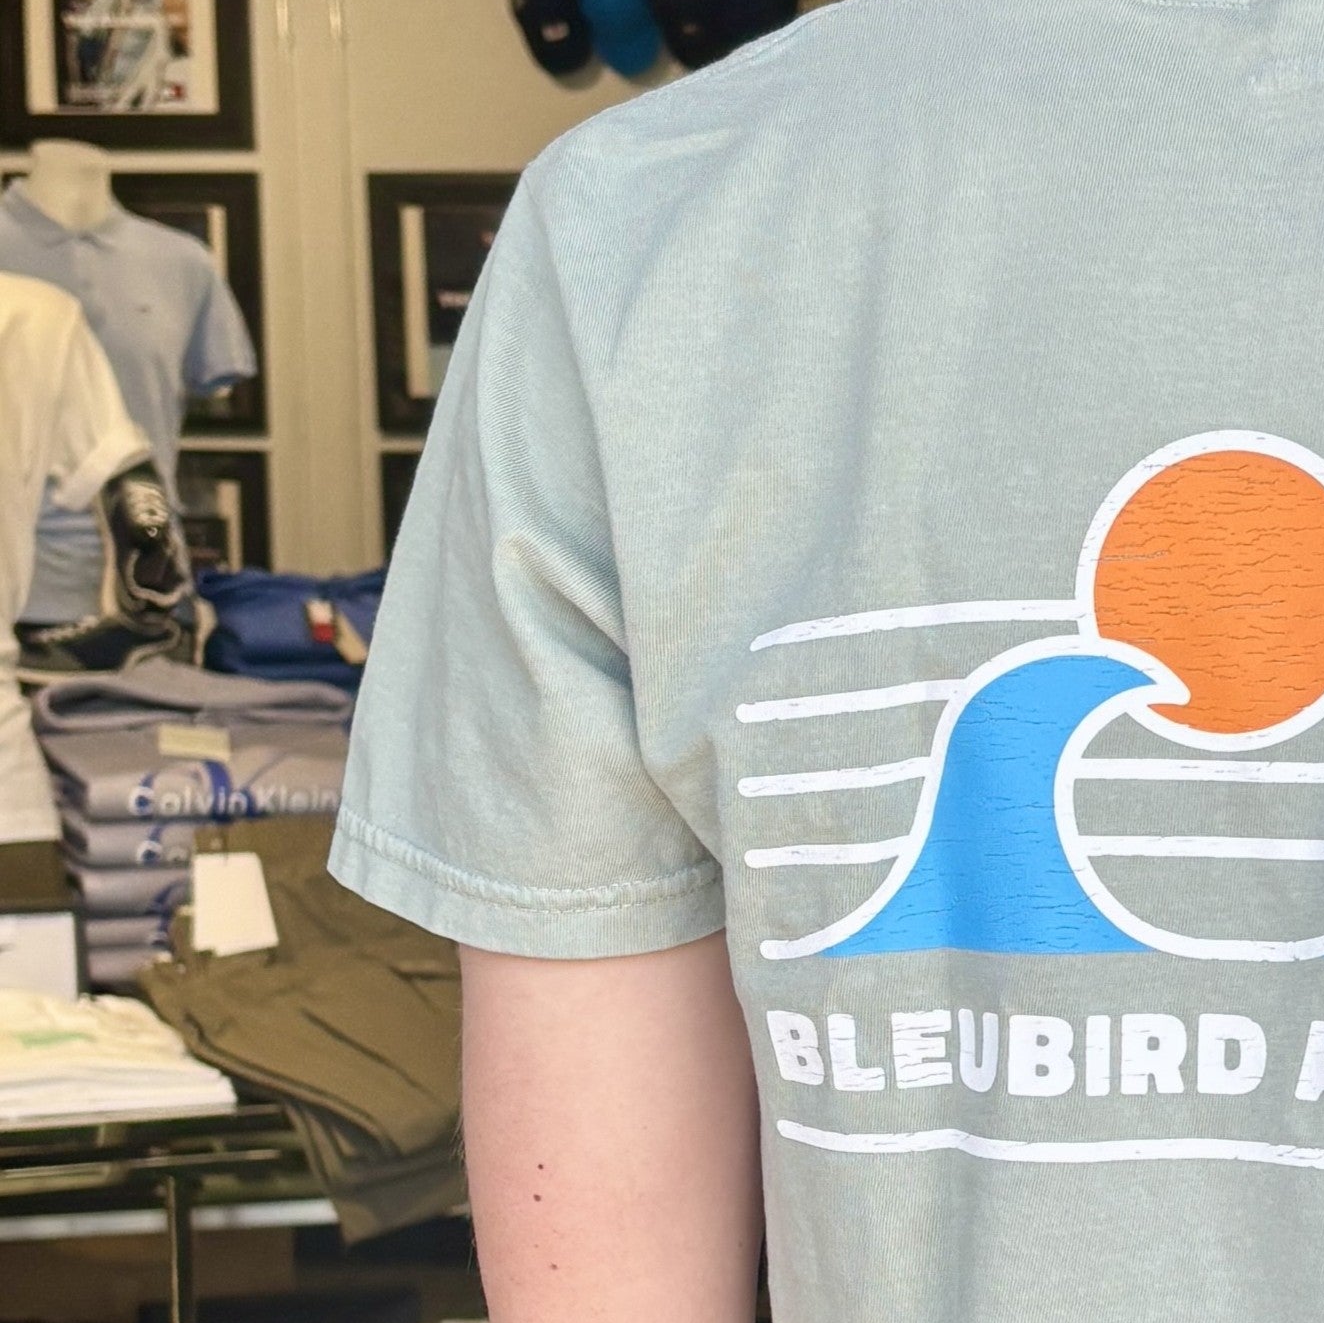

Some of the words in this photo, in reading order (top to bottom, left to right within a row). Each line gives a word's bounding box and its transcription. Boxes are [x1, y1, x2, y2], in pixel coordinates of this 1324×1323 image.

[128, 784, 248, 816] Calvin
[256, 784, 338, 814] Klein
[766, 1007, 1268, 1099] BLEUBIRD
